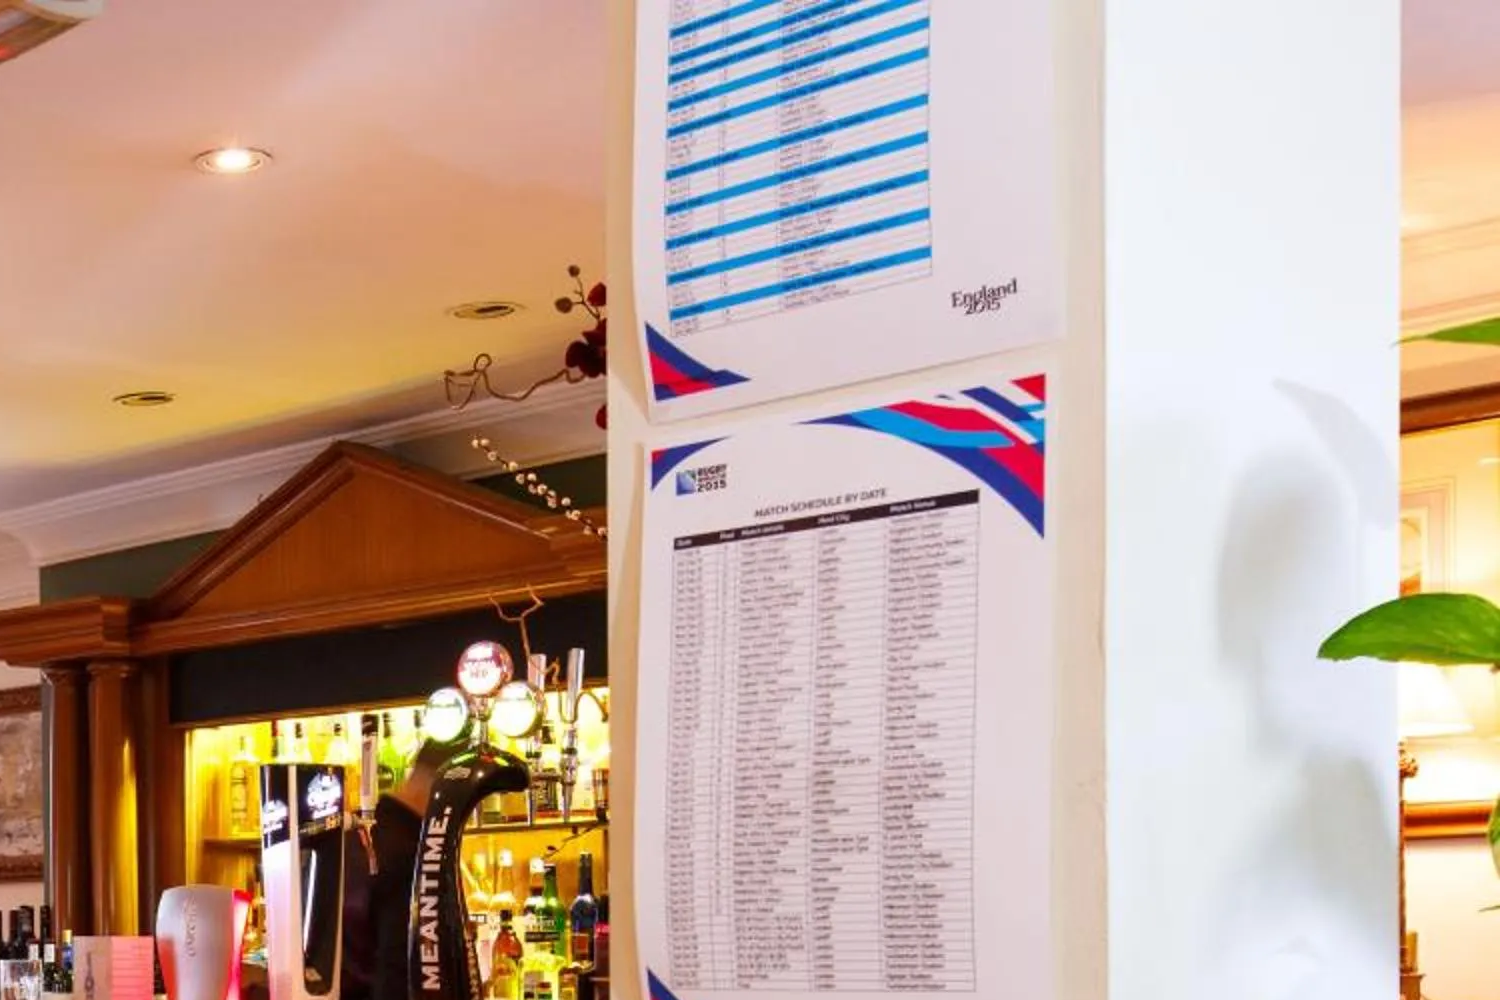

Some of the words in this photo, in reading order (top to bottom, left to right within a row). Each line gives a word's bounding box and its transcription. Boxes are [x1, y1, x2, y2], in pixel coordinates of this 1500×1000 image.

[950, 277, 1018, 309] England
[963, 297, 1001, 315] 2015
[697, 479, 728, 493] 2015
[754, 503, 789, 518] MATCH
[790, 497, 842, 512] SCHEDULE
[844, 491, 859, 505] BY
[859, 487, 888, 501] DATE
